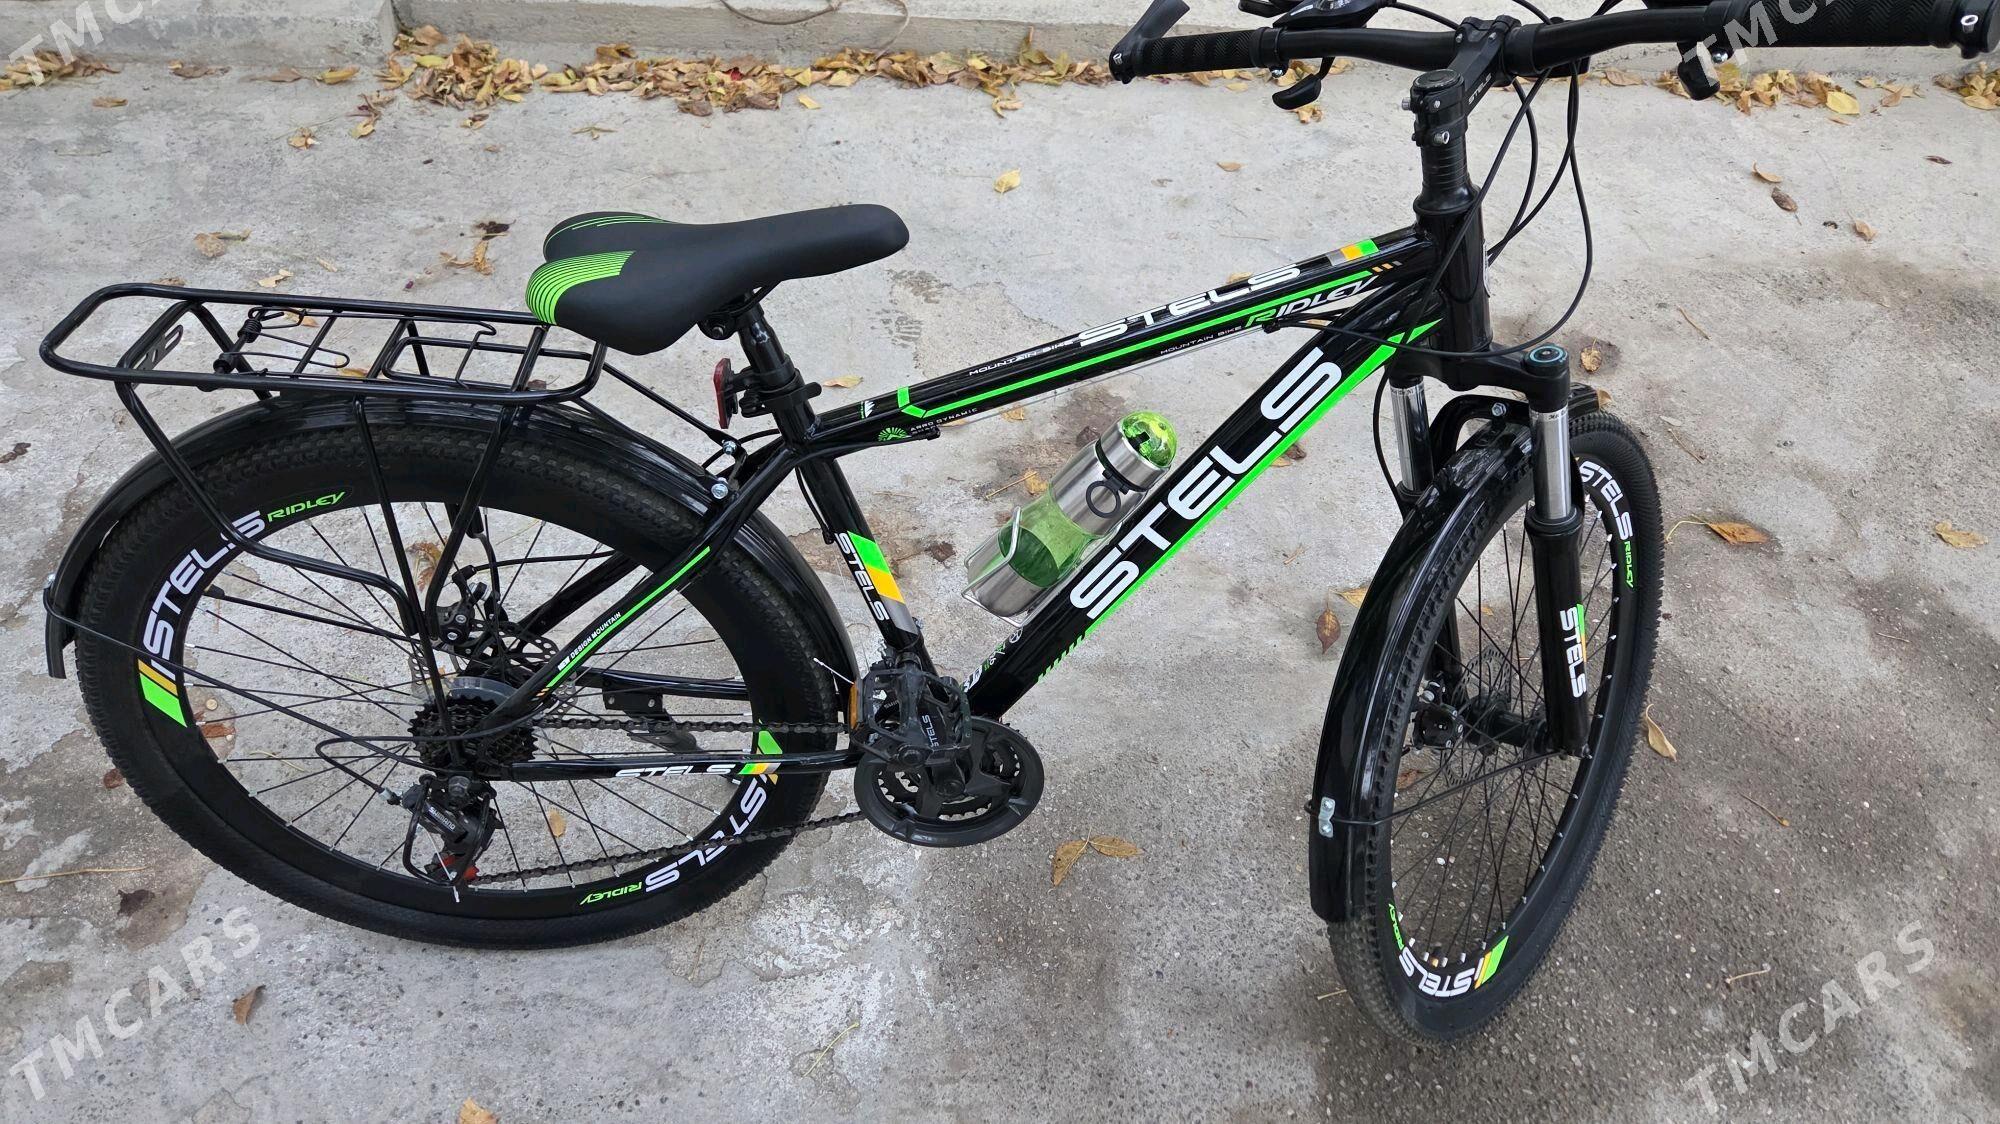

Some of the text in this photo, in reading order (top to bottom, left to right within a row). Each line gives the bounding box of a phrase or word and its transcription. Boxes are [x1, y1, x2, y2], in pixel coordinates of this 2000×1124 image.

[1468, 74, 1492, 105] STELS
[1078, 264, 1300, 347] STELS
[1245, 275, 1380, 328] RIDLEY
[969, 350, 1037, 375] MOUNTAIN
[1161, 326, 1242, 355] MOUNTAIN BIKE
[267, 491, 346, 523] RIDLEY
[1070, 346, 1342, 619] STELS
[1579, 460, 1633, 541] STELS
[143, 510, 266, 659] STELS
[835, 532, 890, 621] STELS
[1623, 540, 1634, 589] RIDLEY
[570, 636, 592, 659] DESIGN
[591, 612, 621, 639] MOUNTAIN
[1560, 606, 1587, 698] STELS
[922, 714, 939, 748] STELS
[615, 764, 736, 778] STELS
[429, 806, 456, 832] SHIMANO
[645, 777, 767, 893] STELS
[580, 881, 643, 906] RIDLEY
[1399, 946, 1476, 997] STELS
